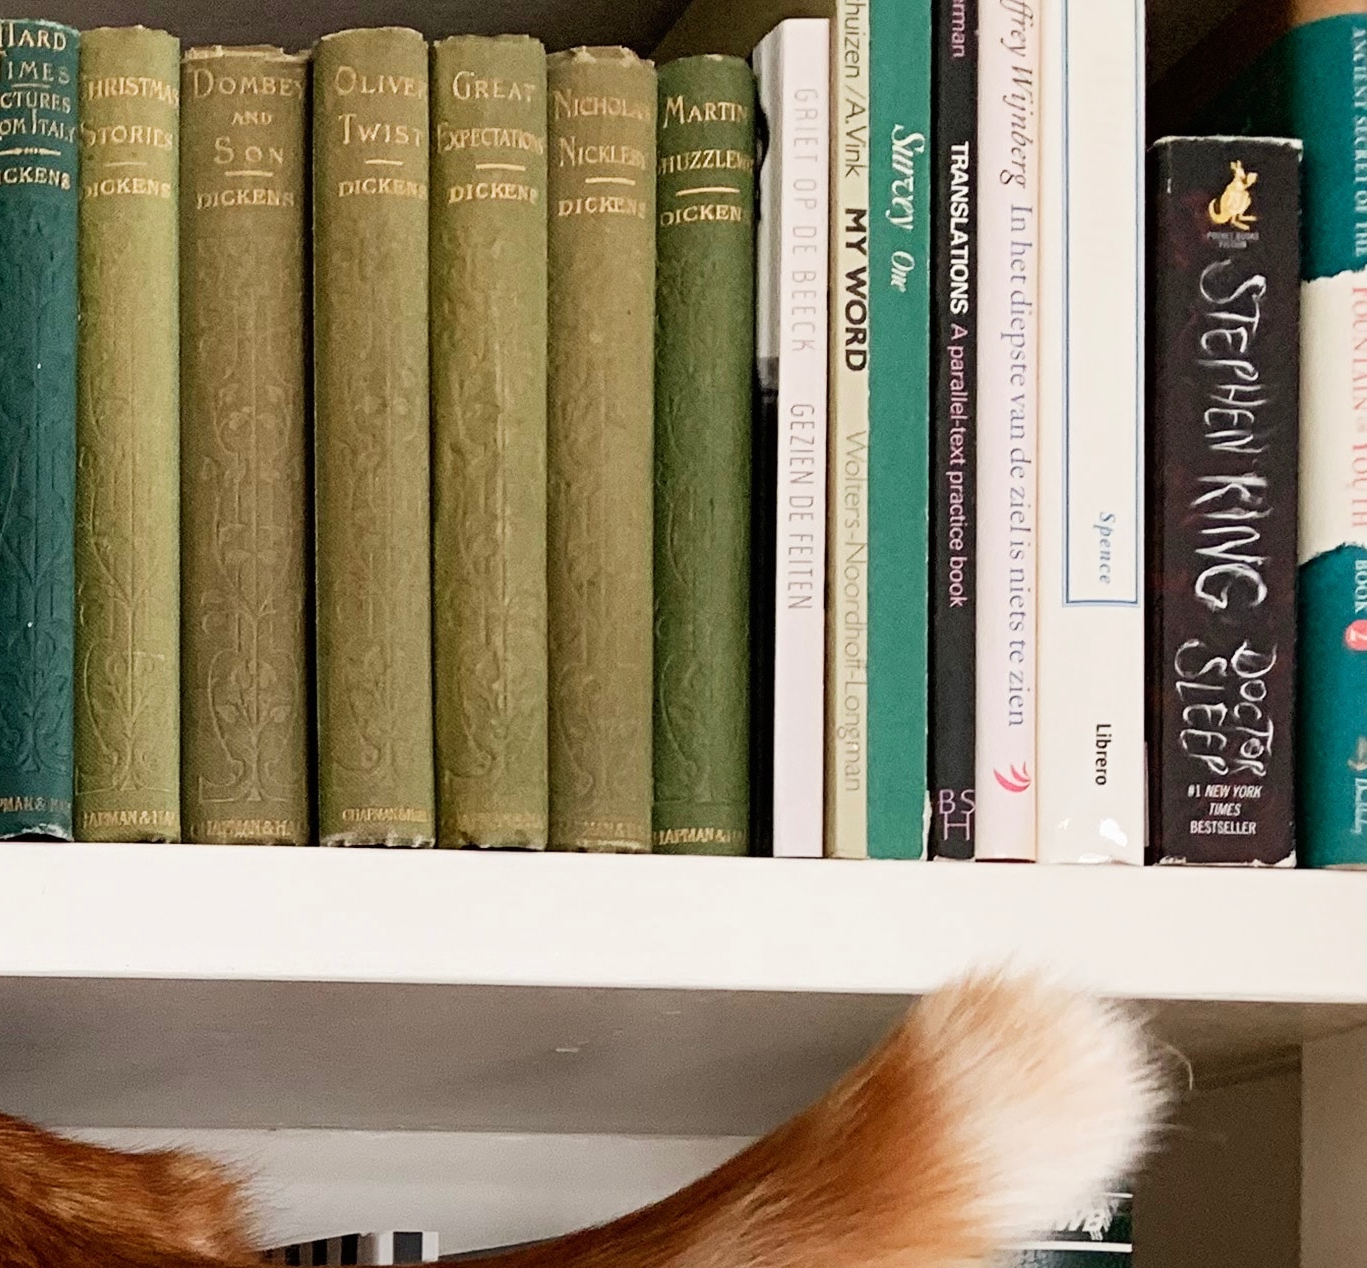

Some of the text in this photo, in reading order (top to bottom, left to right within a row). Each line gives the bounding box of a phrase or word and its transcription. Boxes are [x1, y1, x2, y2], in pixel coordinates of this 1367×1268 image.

[884, 123, 926, 294] Survey One
[843, 208, 869, 374] MY WORD
[1198, 259, 1267, 456] STEPHEN
[945, 140, 971, 609] TRANSLATIONS A parallel-text practice book
[1000, 205, 1034, 728] In het diepste van de ziel is niets te zien
[1091, 511, 1116, 586] Spence
[1194, 473, 1271, 611] KING
[1094, 723, 1113, 787] Librero
[1174, 639, 1229, 778] SLEEP
[1227, 641, 1278, 778] DOCTOR
[1186, 784, 1262, 799] #1 NEW YORK
[1189, 818, 1257, 834] BESTSELLER
[1209, 801, 1242, 816] TIMES
